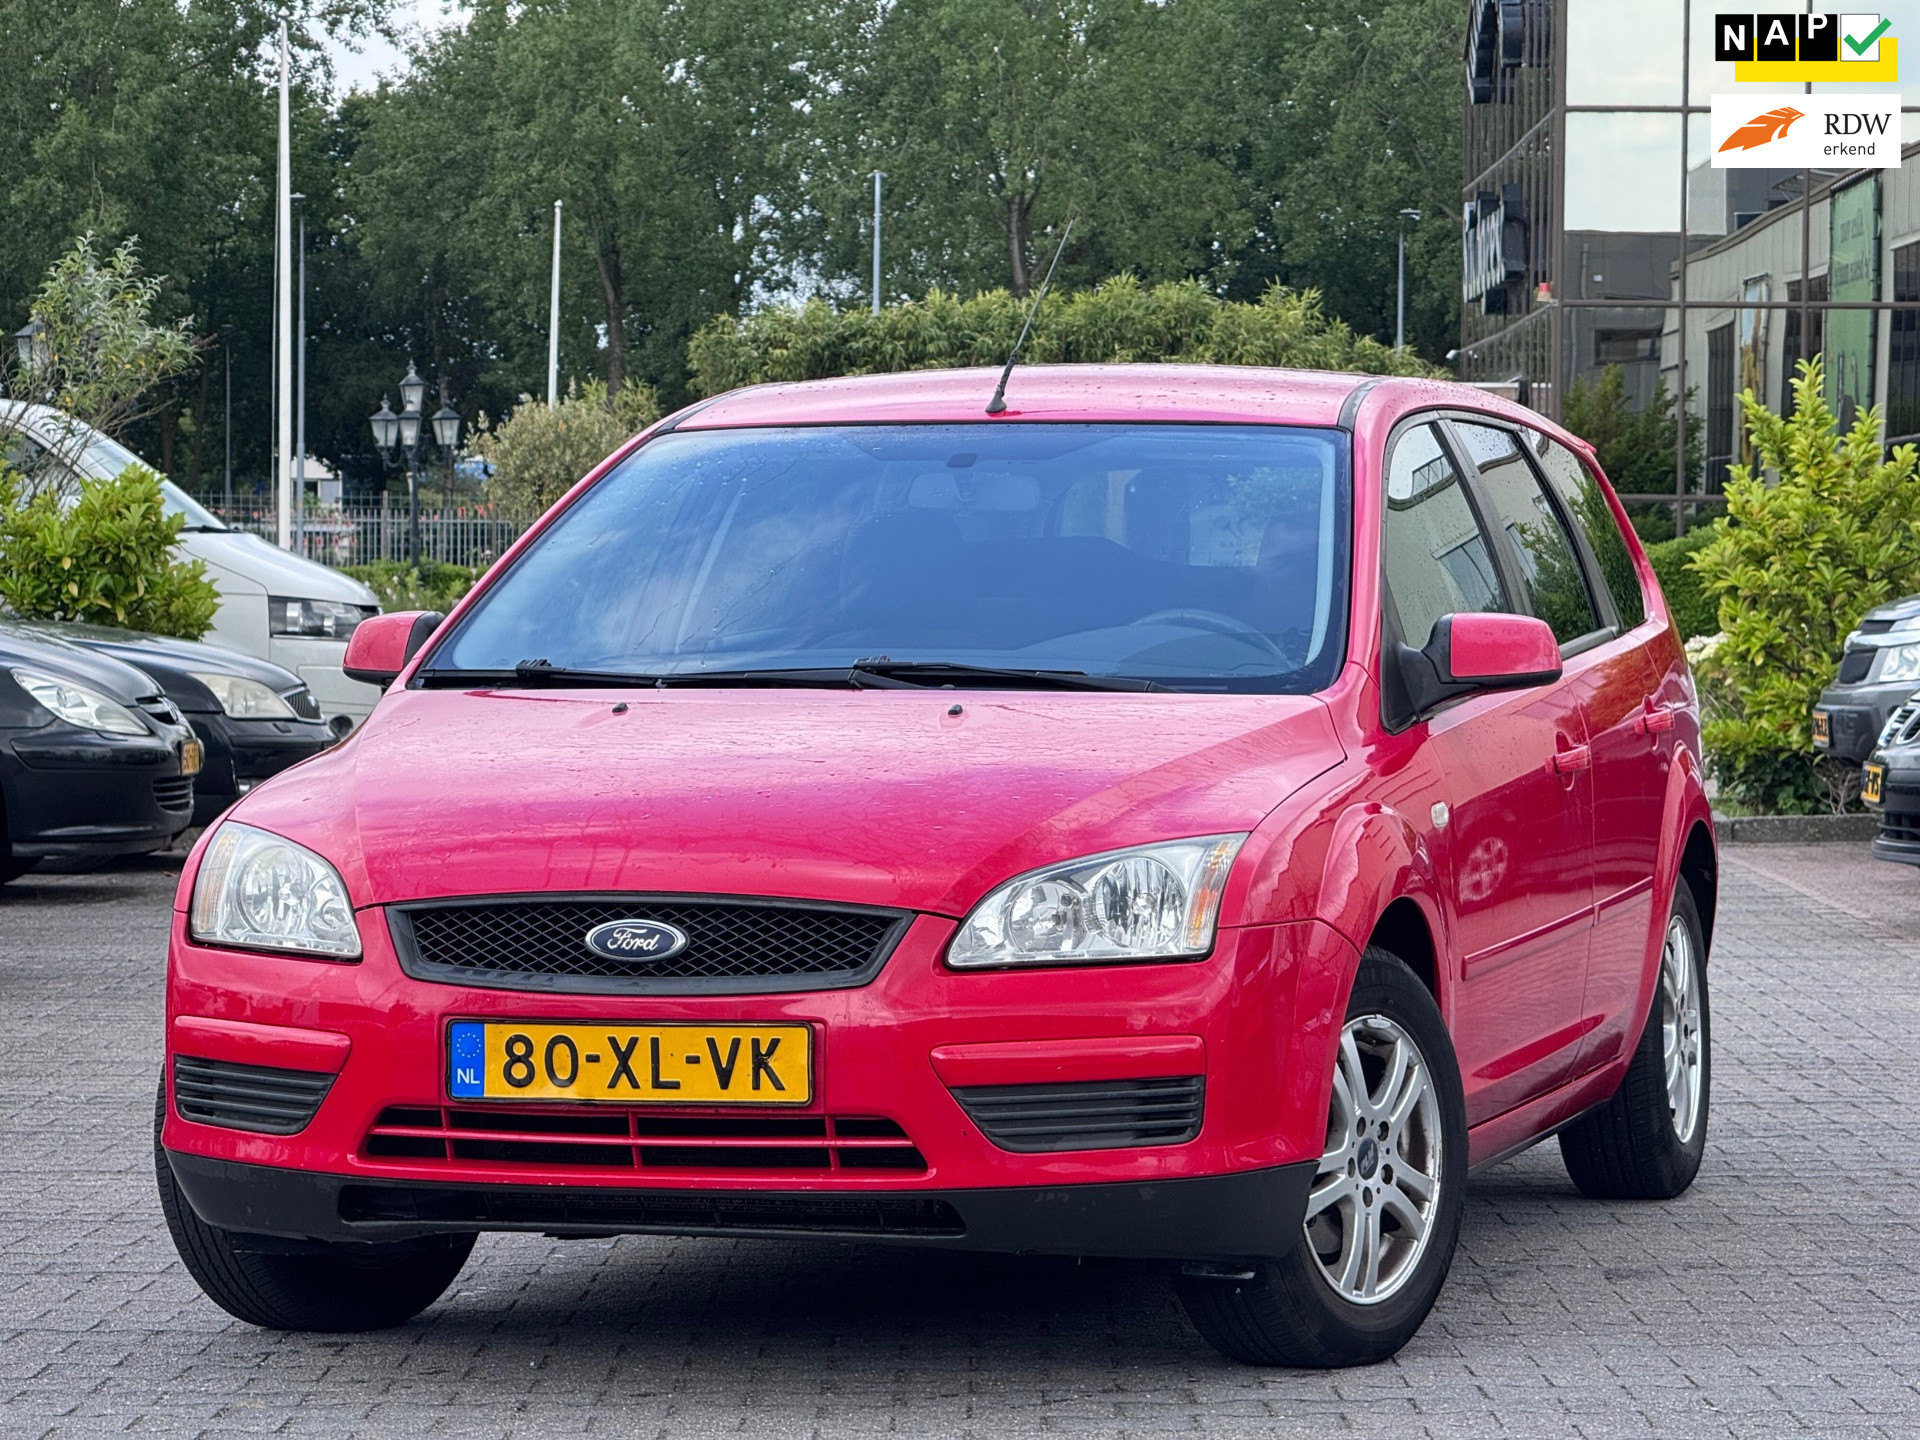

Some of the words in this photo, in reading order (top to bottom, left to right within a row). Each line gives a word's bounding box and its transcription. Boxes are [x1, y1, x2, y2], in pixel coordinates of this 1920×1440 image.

[606, 927, 660, 951] Ford
[502, 1033, 787, 1092] 80-XL-VK
[456, 1067, 481, 1085] NL
